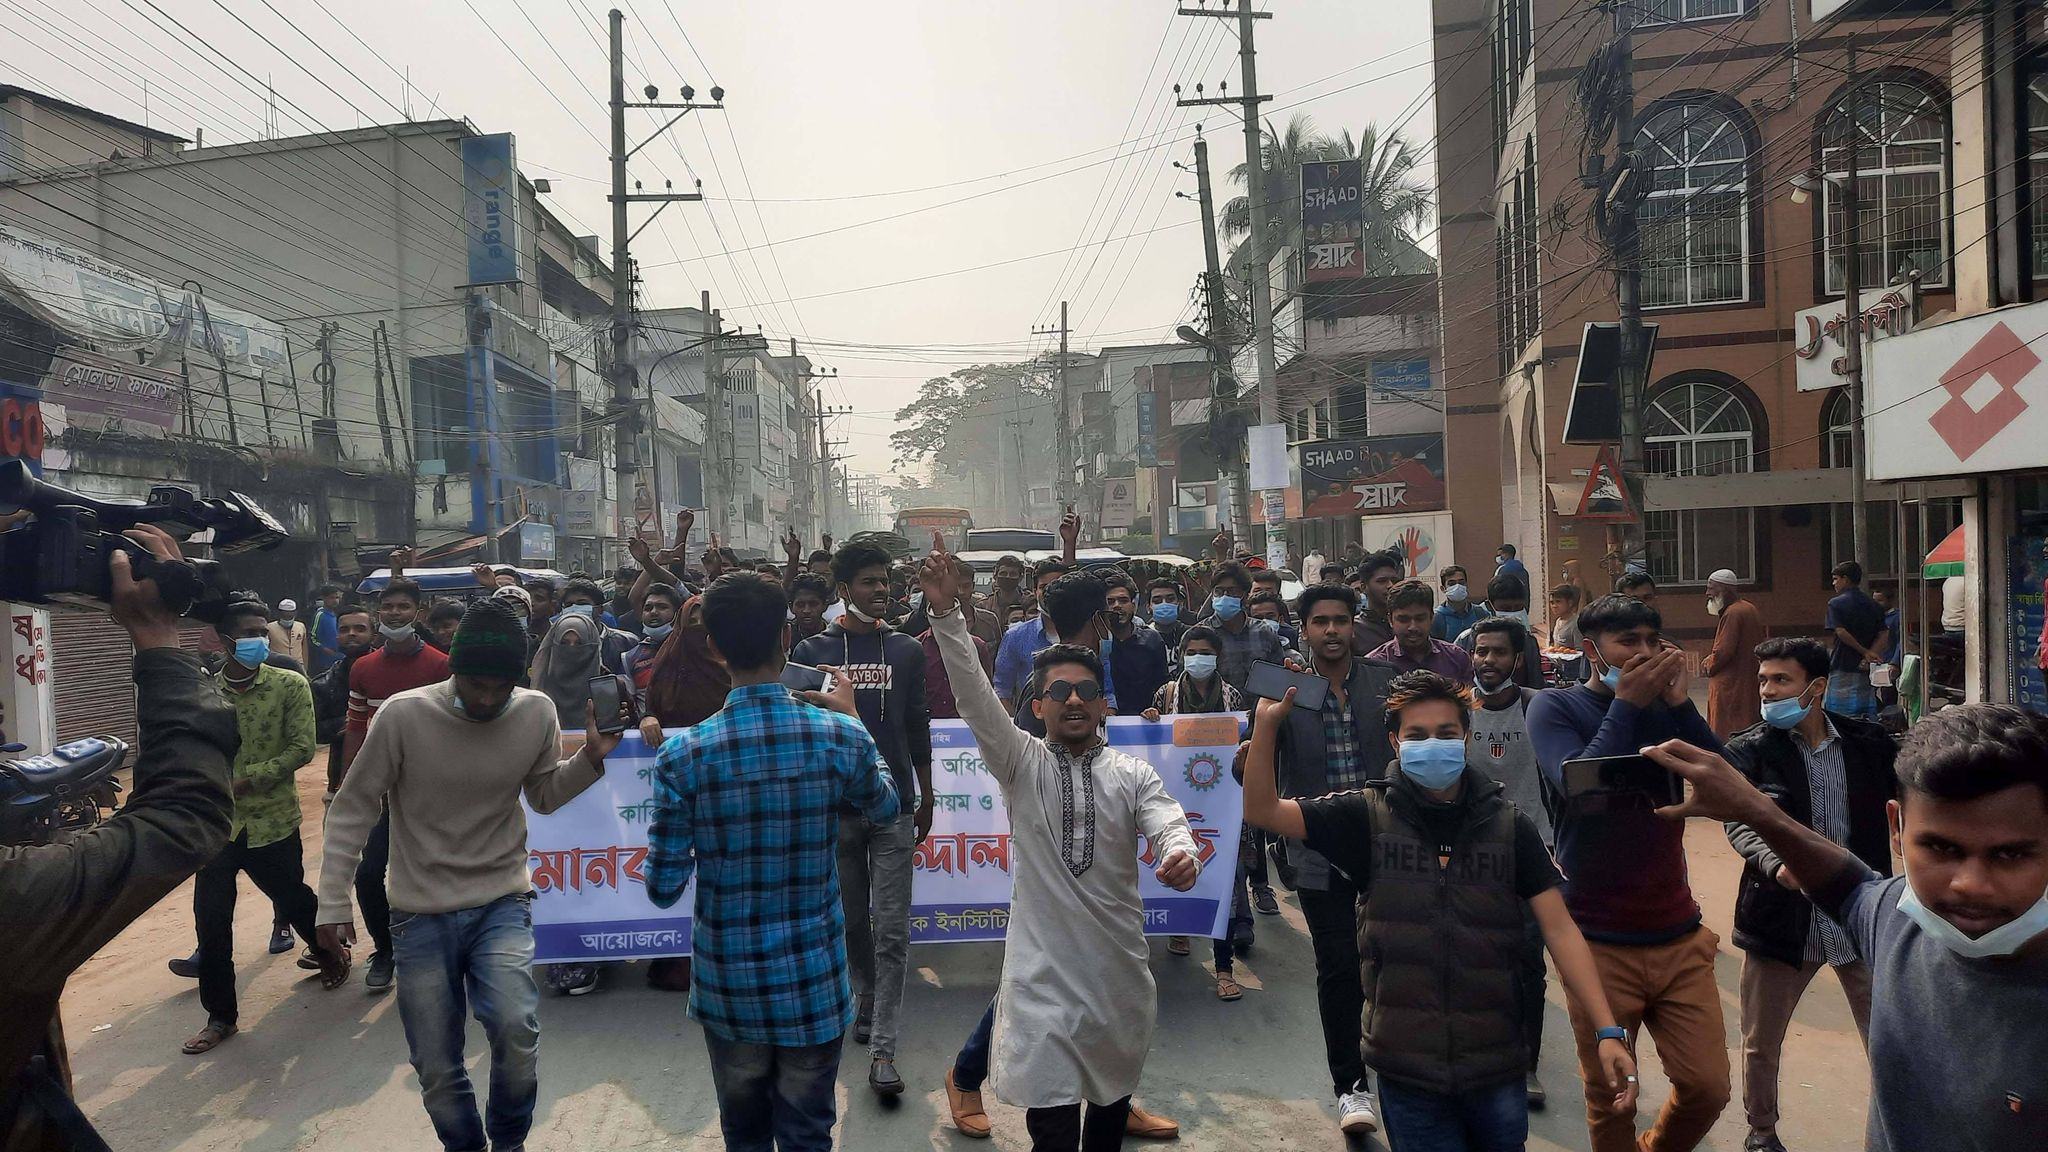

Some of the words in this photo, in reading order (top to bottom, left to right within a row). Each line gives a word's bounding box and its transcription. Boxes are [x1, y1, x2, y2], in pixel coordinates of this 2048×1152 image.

[1305, 187, 1358, 209] SHAAD
[1305, 449, 1354, 468] SHAAD
[852, 670, 885, 682] AYBOY
[1474, 731, 1522, 742] GANT
